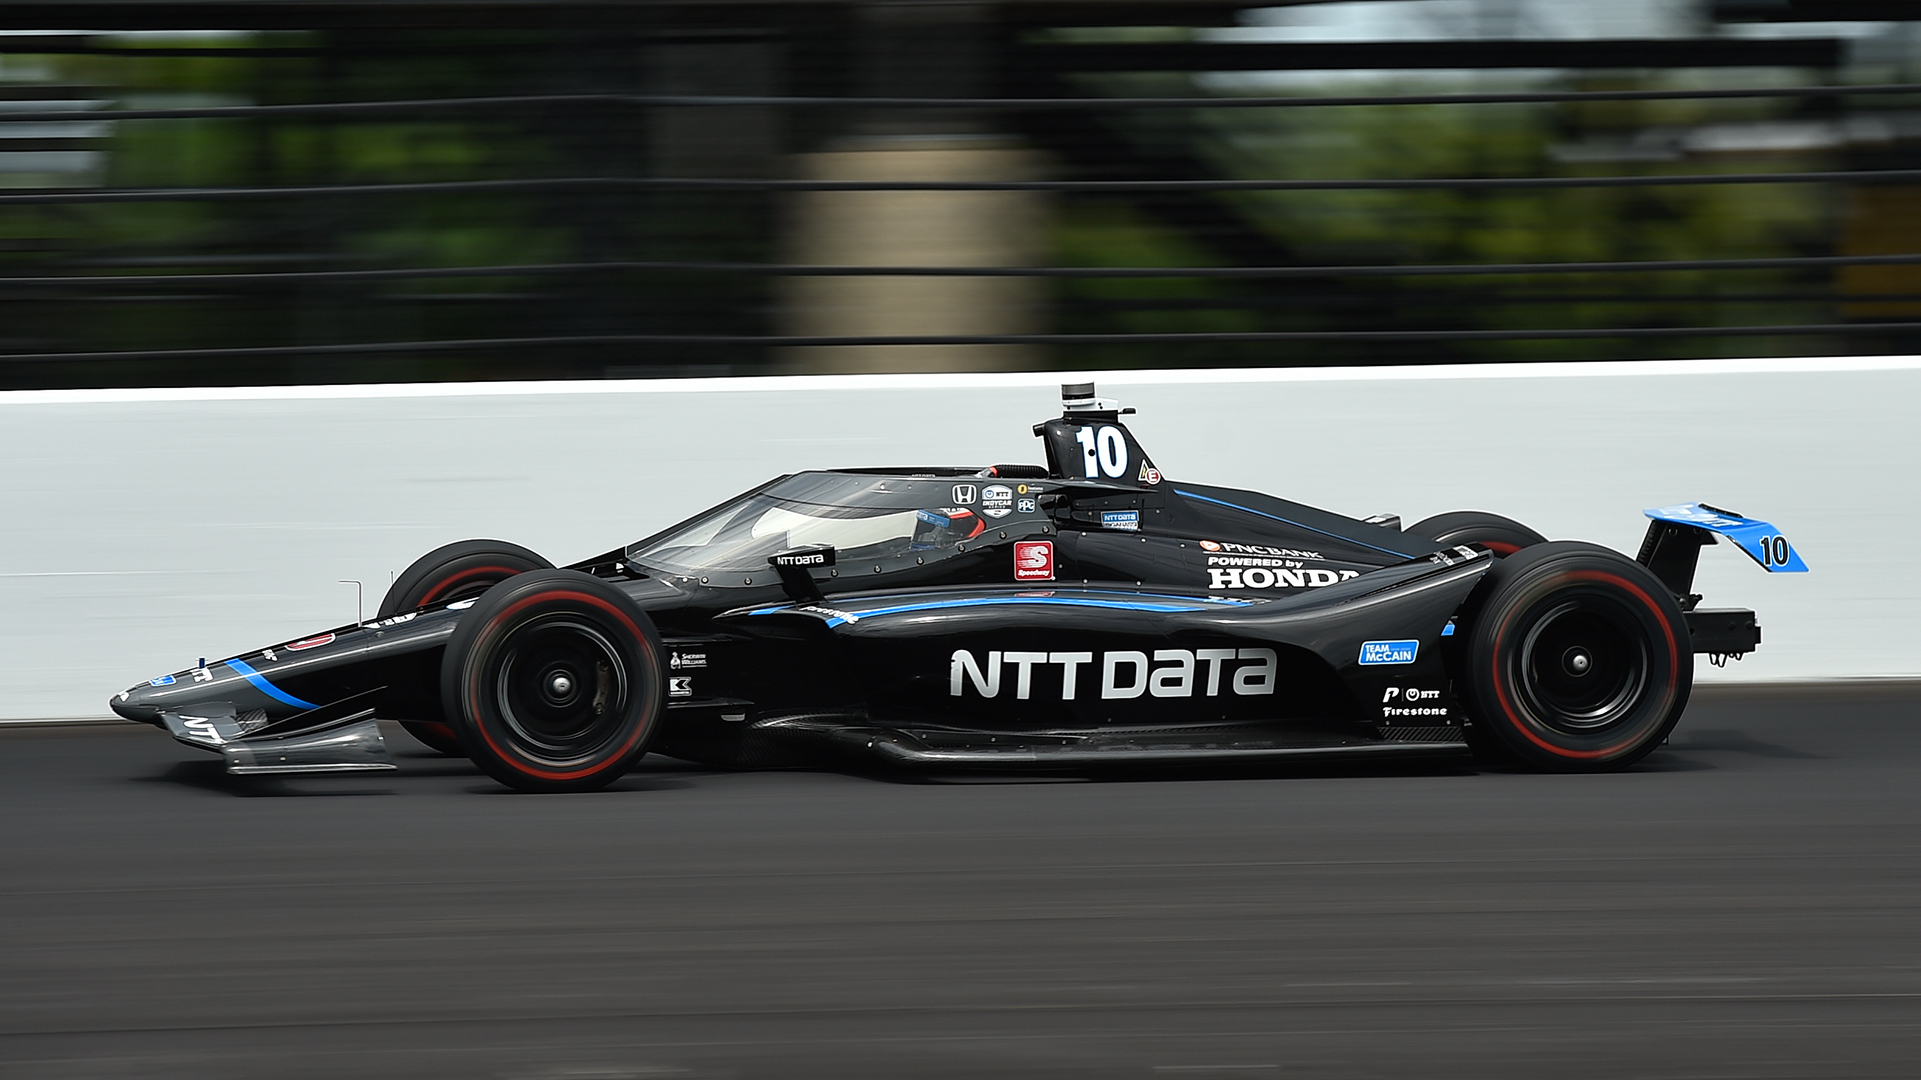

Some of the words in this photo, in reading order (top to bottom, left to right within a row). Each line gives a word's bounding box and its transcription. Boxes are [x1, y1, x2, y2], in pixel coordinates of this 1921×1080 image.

[1076, 426, 1128, 478] 10
[1761, 535, 1789, 566] 10
[777, 556, 795, 565] NTT
[1208, 556, 1282, 567] POWERED
[1286, 559, 1304, 569] by
[1018, 569, 1051, 578] Speedway
[1365, 644, 1390, 653] TEAM
[1365, 651, 1412, 661] McCAIN
[950, 649, 1093, 700] NTT
[1382, 706, 1448, 718] Firestone
